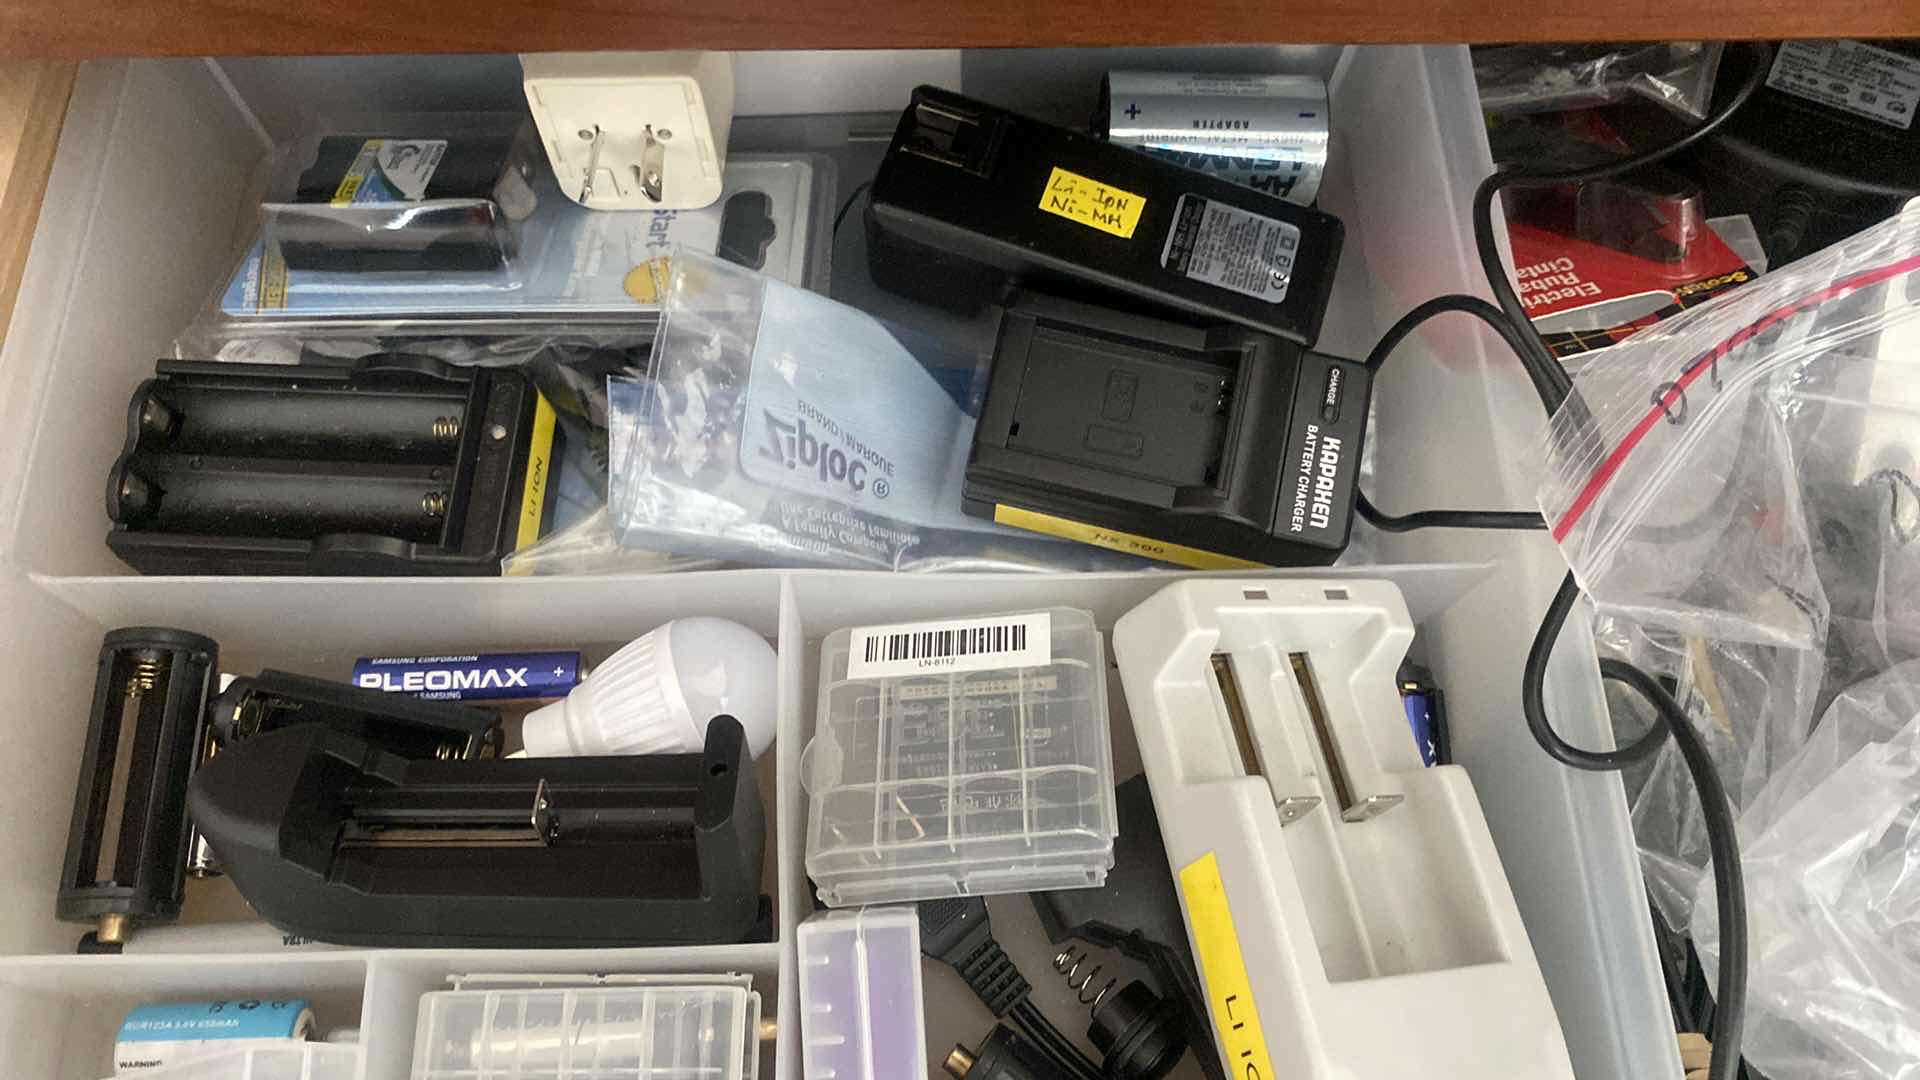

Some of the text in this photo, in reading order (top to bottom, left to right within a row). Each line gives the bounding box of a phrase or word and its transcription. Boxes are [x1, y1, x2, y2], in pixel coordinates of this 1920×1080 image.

[1325, 367, 1341, 406] CHARGE
[1290, 424, 1319, 533] BATTERY CHARGER
[371, 655, 480, 665] SAMSUNG CORPORATION
[359, 667, 529, 692] PLEOMAX
